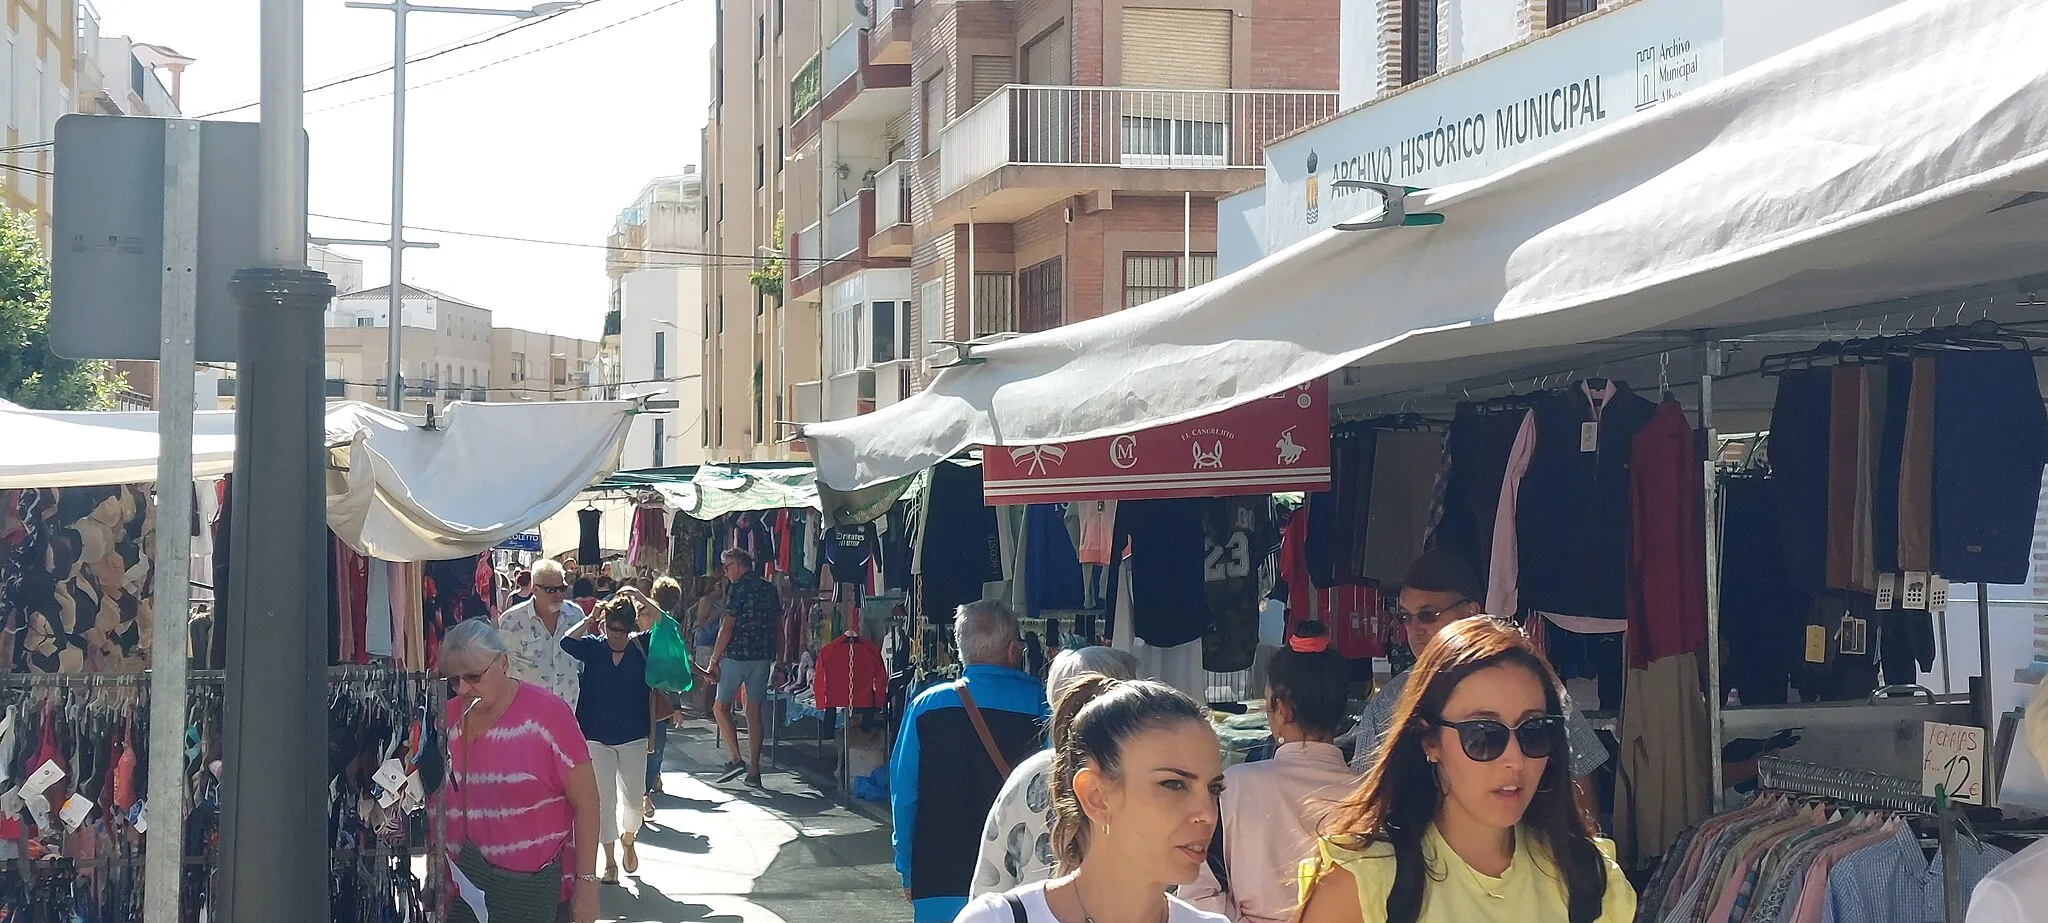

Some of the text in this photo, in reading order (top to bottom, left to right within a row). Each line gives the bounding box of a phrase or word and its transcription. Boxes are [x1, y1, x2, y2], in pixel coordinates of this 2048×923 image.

[1659, 54, 1698, 82] Municipal
[1660, 37, 1690, 60] Archivo
[1331, 75, 1606, 199] ARCHIVO HISTÓRICO MUNICIPAL
[1204, 531, 1250, 583] 23
